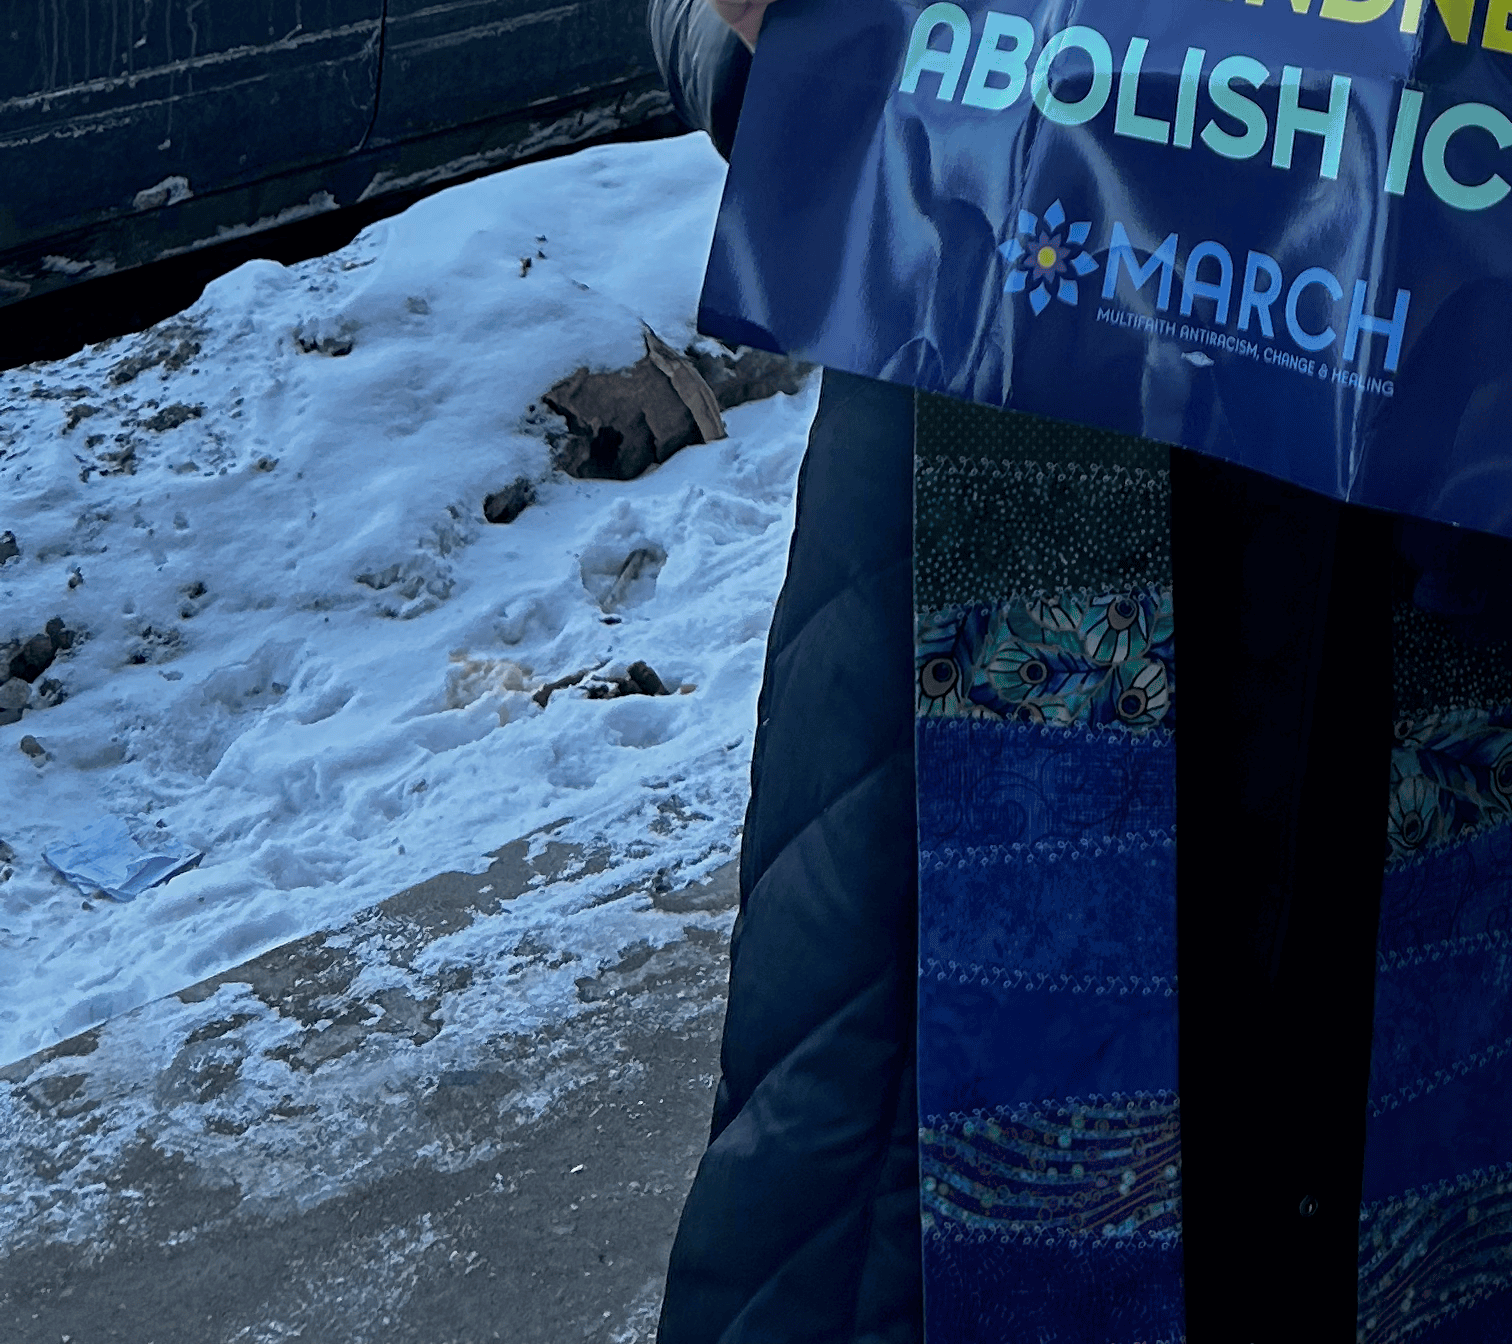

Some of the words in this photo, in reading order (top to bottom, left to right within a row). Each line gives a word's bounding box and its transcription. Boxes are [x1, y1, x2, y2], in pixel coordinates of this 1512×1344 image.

[898, 2, 1350, 179] ABOLISH
[1097, 307, 1177, 337] MULTIFAITH
[1179, 324, 1260, 361] ANTIRACISM,
[1264, 347, 1315, 375] CHANGE
[1318, 363, 1328, 379] &
[1331, 367, 1395, 397] HEALING
[1101, 221, 1411, 372] MARCH
